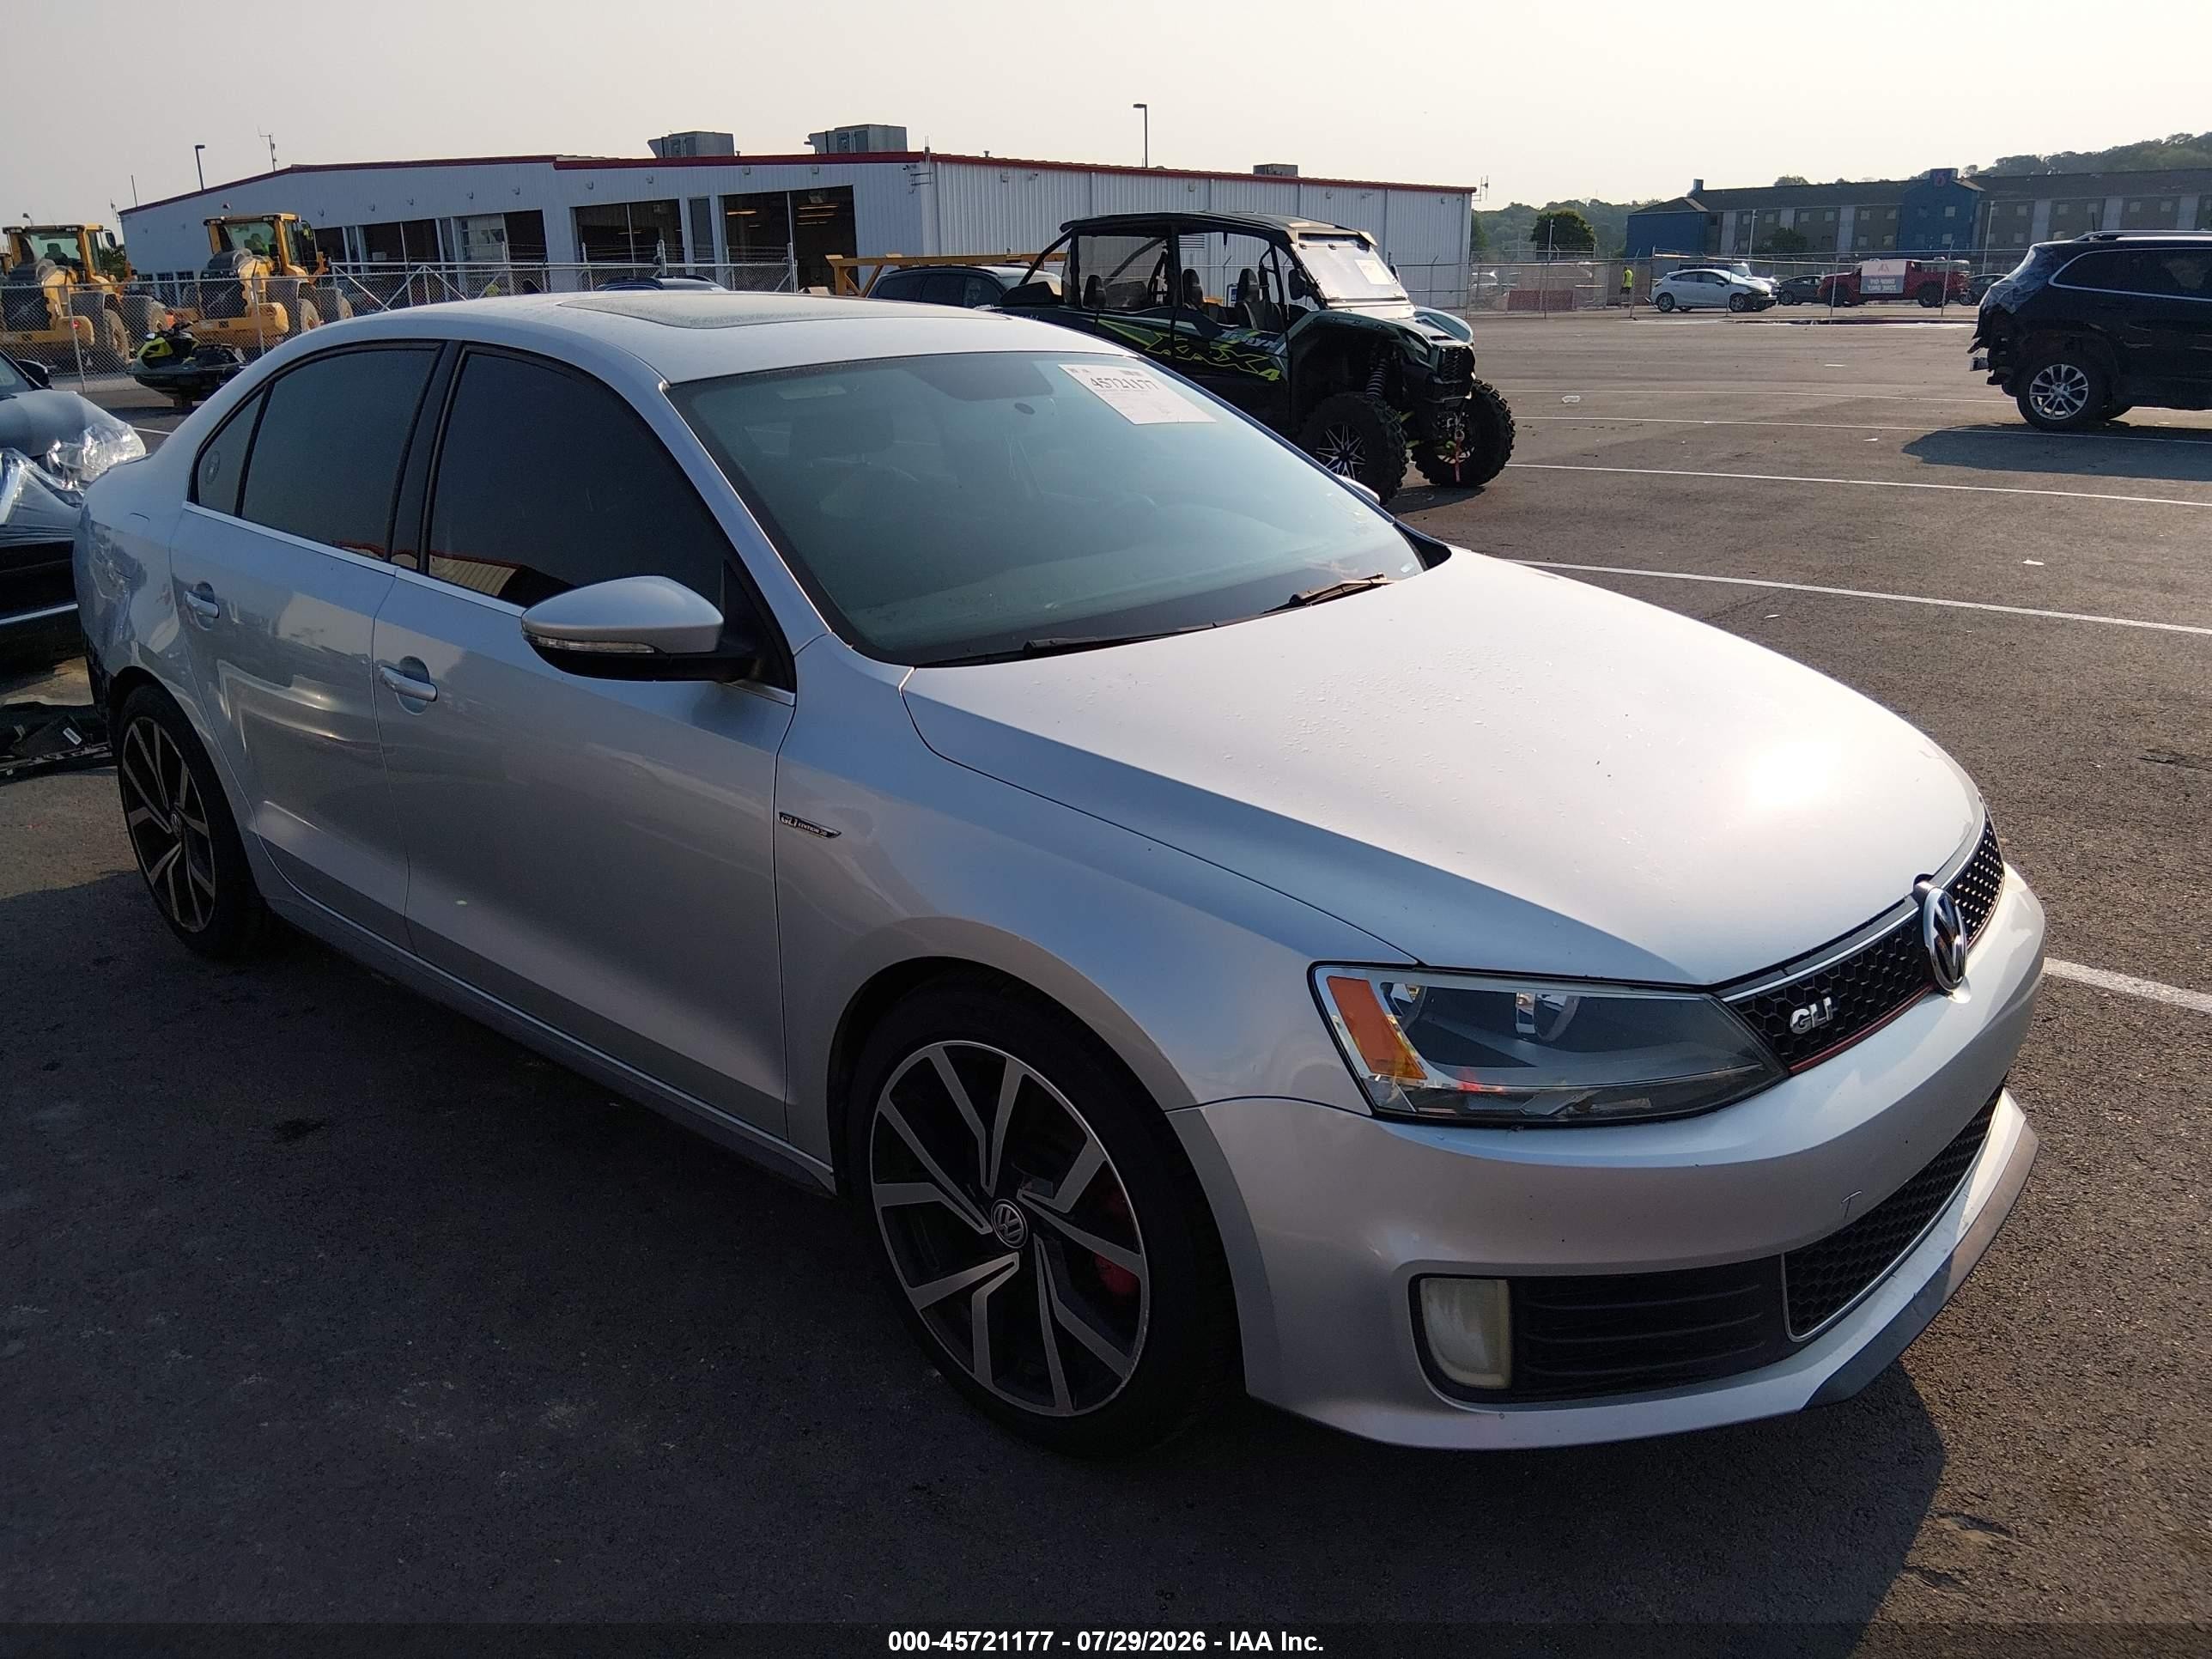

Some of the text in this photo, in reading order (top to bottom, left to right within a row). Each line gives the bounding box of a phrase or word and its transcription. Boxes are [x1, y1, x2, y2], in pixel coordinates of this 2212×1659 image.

[1090, 377, 1159, 391] 45721177
[781, 815, 798, 828] GLI
[1790, 996, 1833, 1035] GLI
